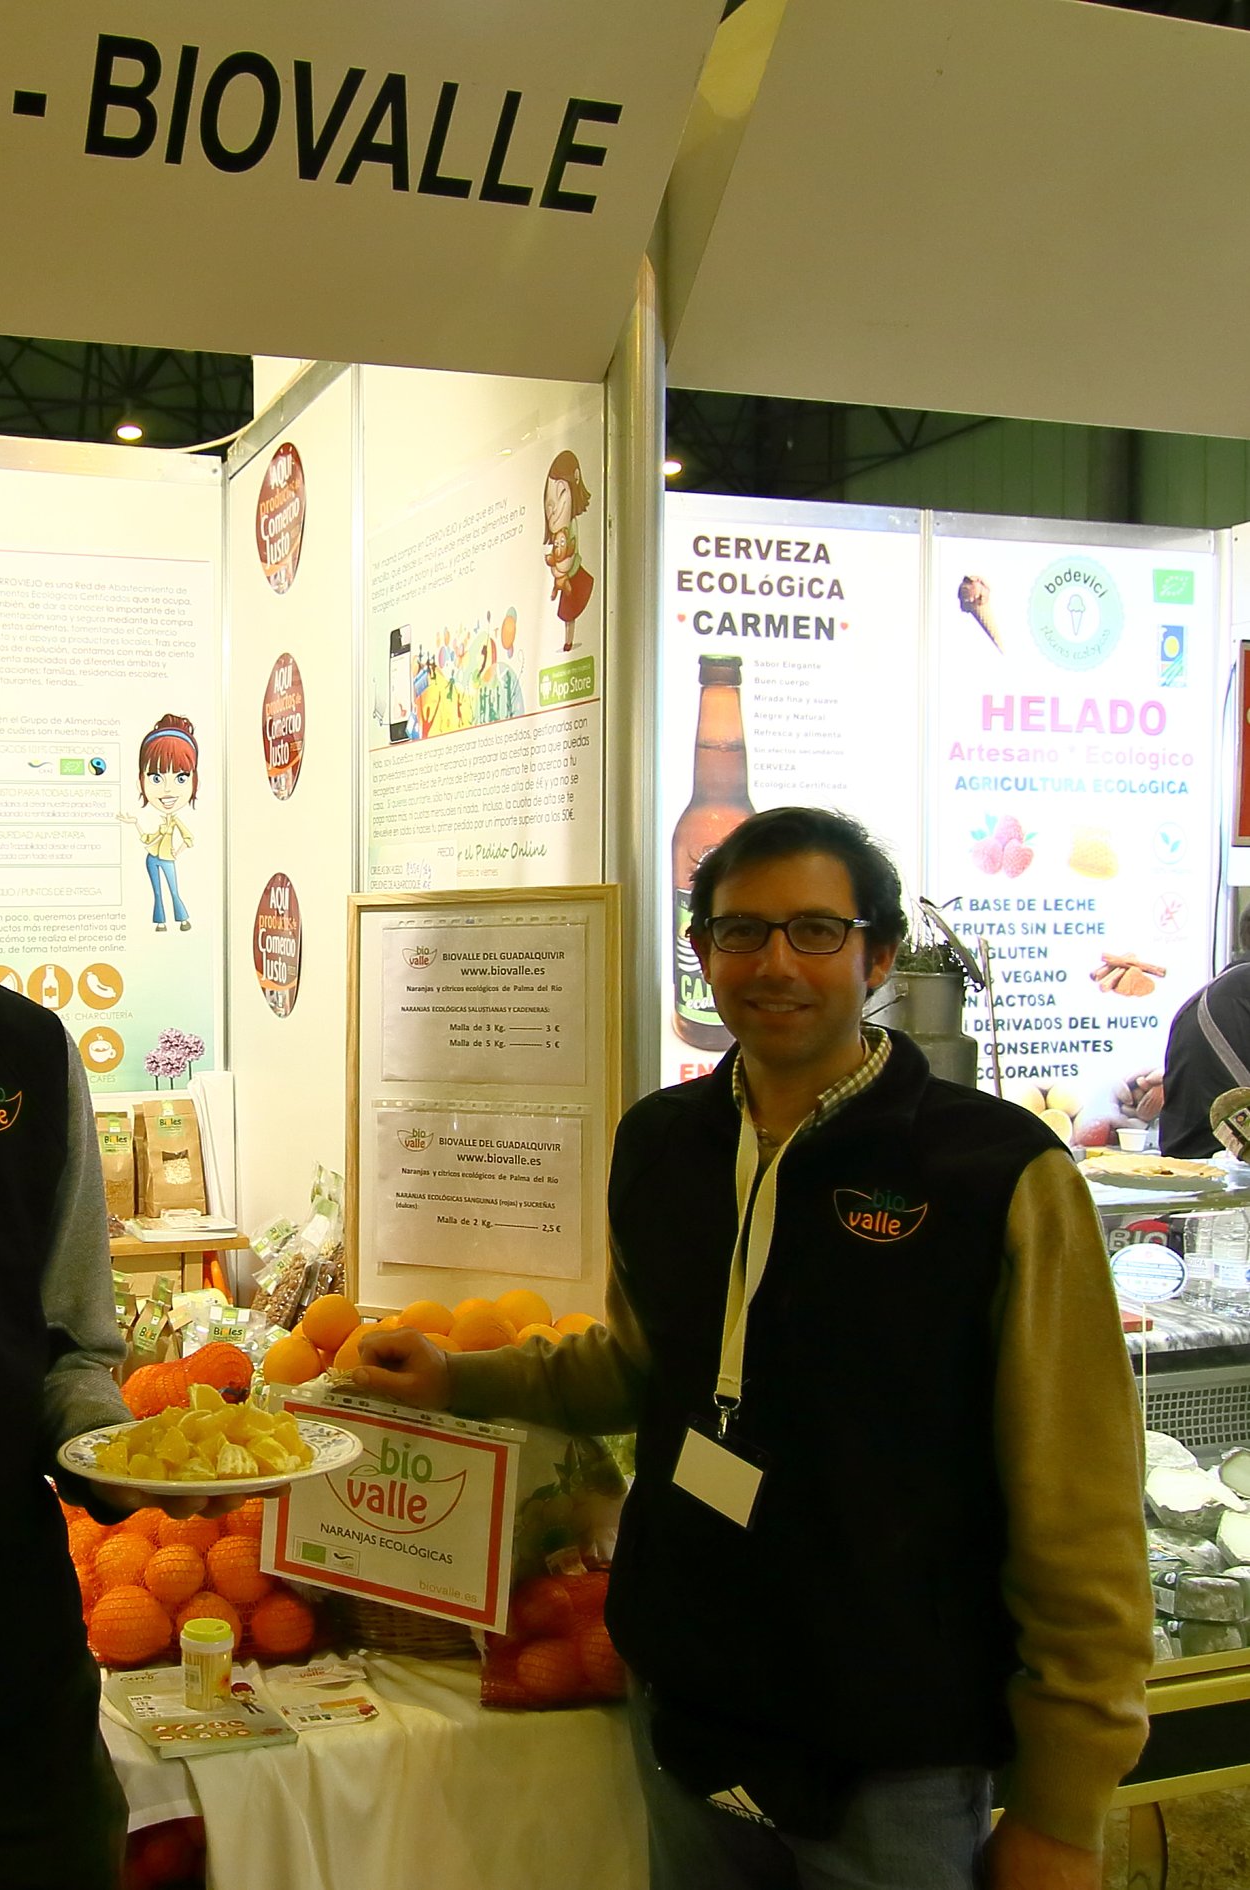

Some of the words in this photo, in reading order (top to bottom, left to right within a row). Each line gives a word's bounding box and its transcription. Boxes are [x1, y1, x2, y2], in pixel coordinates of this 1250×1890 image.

[85, 33, 623, 213] BIOVALLE
[265, 532, 290, 569] Justo
[693, 535, 830, 564] CERVEZA
[693, 611, 834, 640] CARMEN
[553, 681, 569, 699] App
[570, 675, 591, 692] Store
[982, 695, 1167, 736] HELADO
[269, 739, 290, 769] Justo
[949, 742, 1058, 762] Artesano
[1086, 746, 1193, 770] Ecológico
[955, 776, 1086, 792] AGRICULTURA
[476, 844, 509, 861] Pedido
[511, 842, 547, 859] Online
[953, 899, 963, 911] A
[970, 899, 1011, 911] BASE
[1017, 899, 1036, 911] DE
[1044, 899, 1095, 911] LECHE
[954, 923, 1015, 935] FRUTAS
[1054, 923, 1105, 934] LECHE
[417, 946, 429, 955] bio
[443, 952, 480, 961] BIOVALLE
[500, 952, 564, 961] GUADALQUIVIR
[988, 947, 1047, 959] GLUTEN
[262, 952, 287, 984] Justo
[409, 956, 429, 966] valle
[461, 966, 545, 975] www.biovalle.es
[1002, 971, 1067, 983] VEGANO
[466, 985, 498, 993] ecológicos
[1068, 1017, 1099, 1029] DEL
[1107, 1016, 1158, 1028] HUEVO
[984, 1040, 1113, 1055] CONSERVANTES
[412, 1129, 425, 1137] bio
[405, 1139, 425, 1148] valle
[439, 1138, 477, 1147] BIOVALLE
[496, 1140, 561, 1151] GUADALQUIVIR
[457, 1153, 541, 1166] www.biovalle.es
[402, 1168, 429, 1176] Naranjas
[510, 1174, 530, 1182] Palma
[874, 1188, 905, 1212] bio
[437, 1216, 457, 1224] Malla
[543, 1225, 554, 1233] 2,5
[849, 1211, 901, 1235] valle
[380, 1437, 432, 1483] bio
[347, 1478, 427, 1523] valle
[321, 1523, 376, 1545] NARANJAS
[380, 1537, 453, 1564] ECOLÓGICAS
[419, 1580, 477, 1603] biovalle.es
